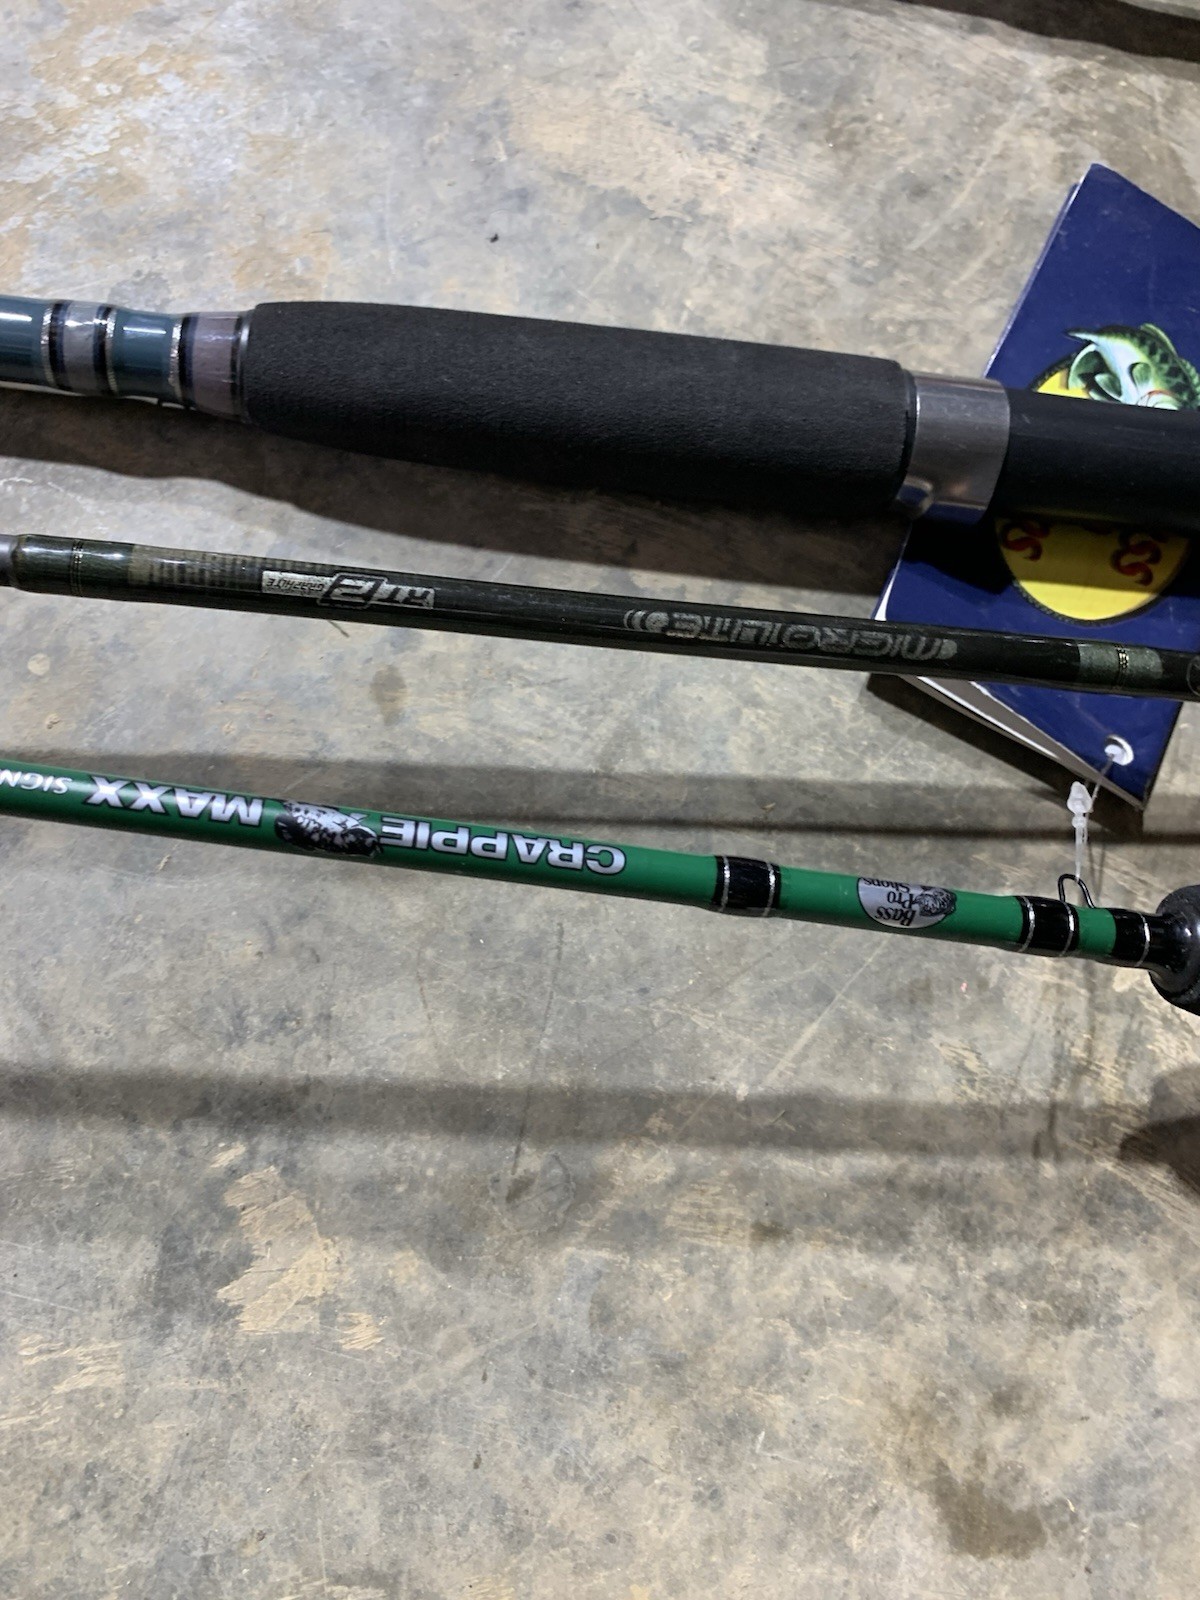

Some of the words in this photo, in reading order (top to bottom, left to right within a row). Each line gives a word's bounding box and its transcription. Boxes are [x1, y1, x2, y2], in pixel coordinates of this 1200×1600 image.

[664, 611, 944, 660] MICROLITE
[85, 774, 264, 827] MAXX
[379, 816, 626, 875] CRAPPIE
[874, 906, 916, 926] Bass
[887, 891, 914, 909] Pro
